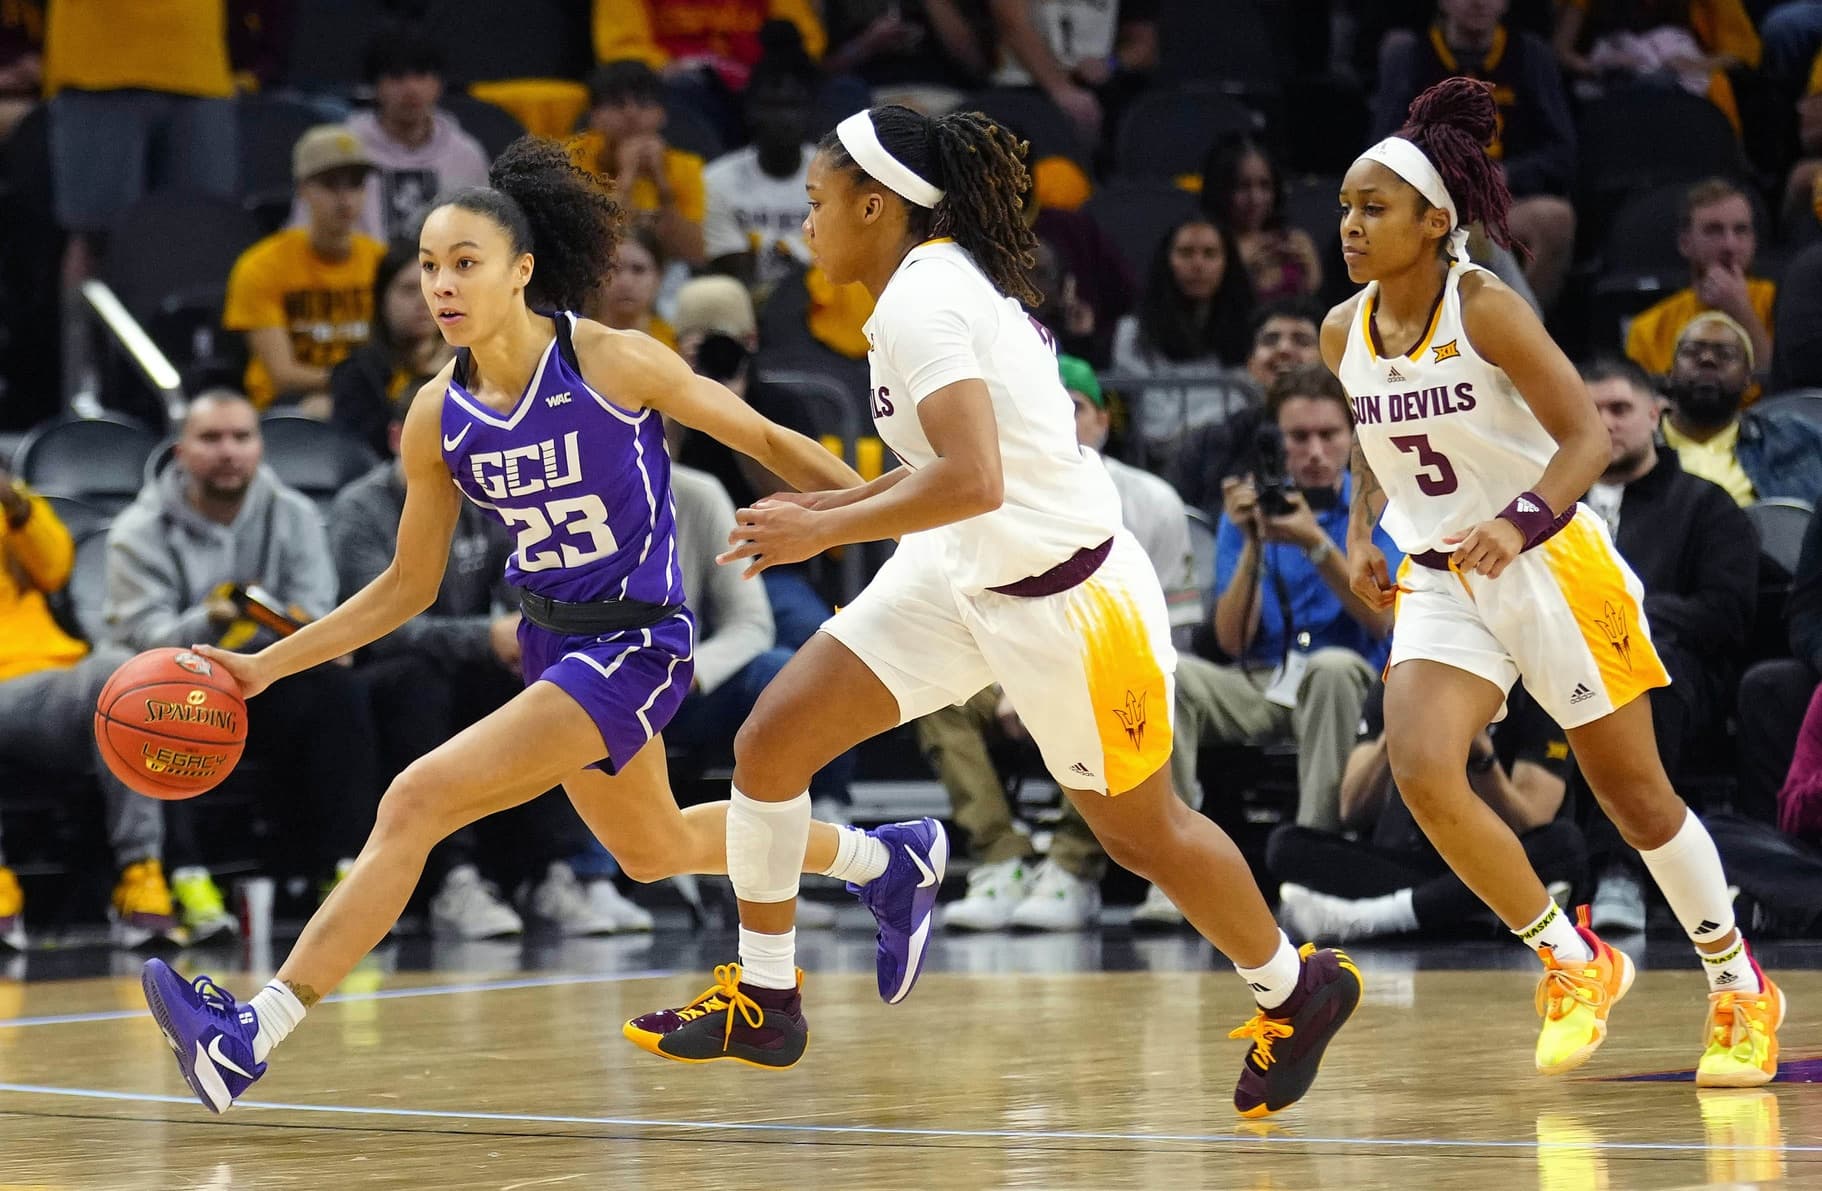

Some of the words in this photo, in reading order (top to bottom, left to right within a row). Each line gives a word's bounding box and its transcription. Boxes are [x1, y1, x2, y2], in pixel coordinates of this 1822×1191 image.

[545, 392, 572, 408] WAC
[1388, 383, 1477, 423] DEVILS
[470, 431, 582, 499] GCU
[1389, 434, 1458, 497] 3
[496, 494, 619, 573] 23
[145, 698, 238, 734] SPALDING
[142, 742, 228, 769] LEGACY
